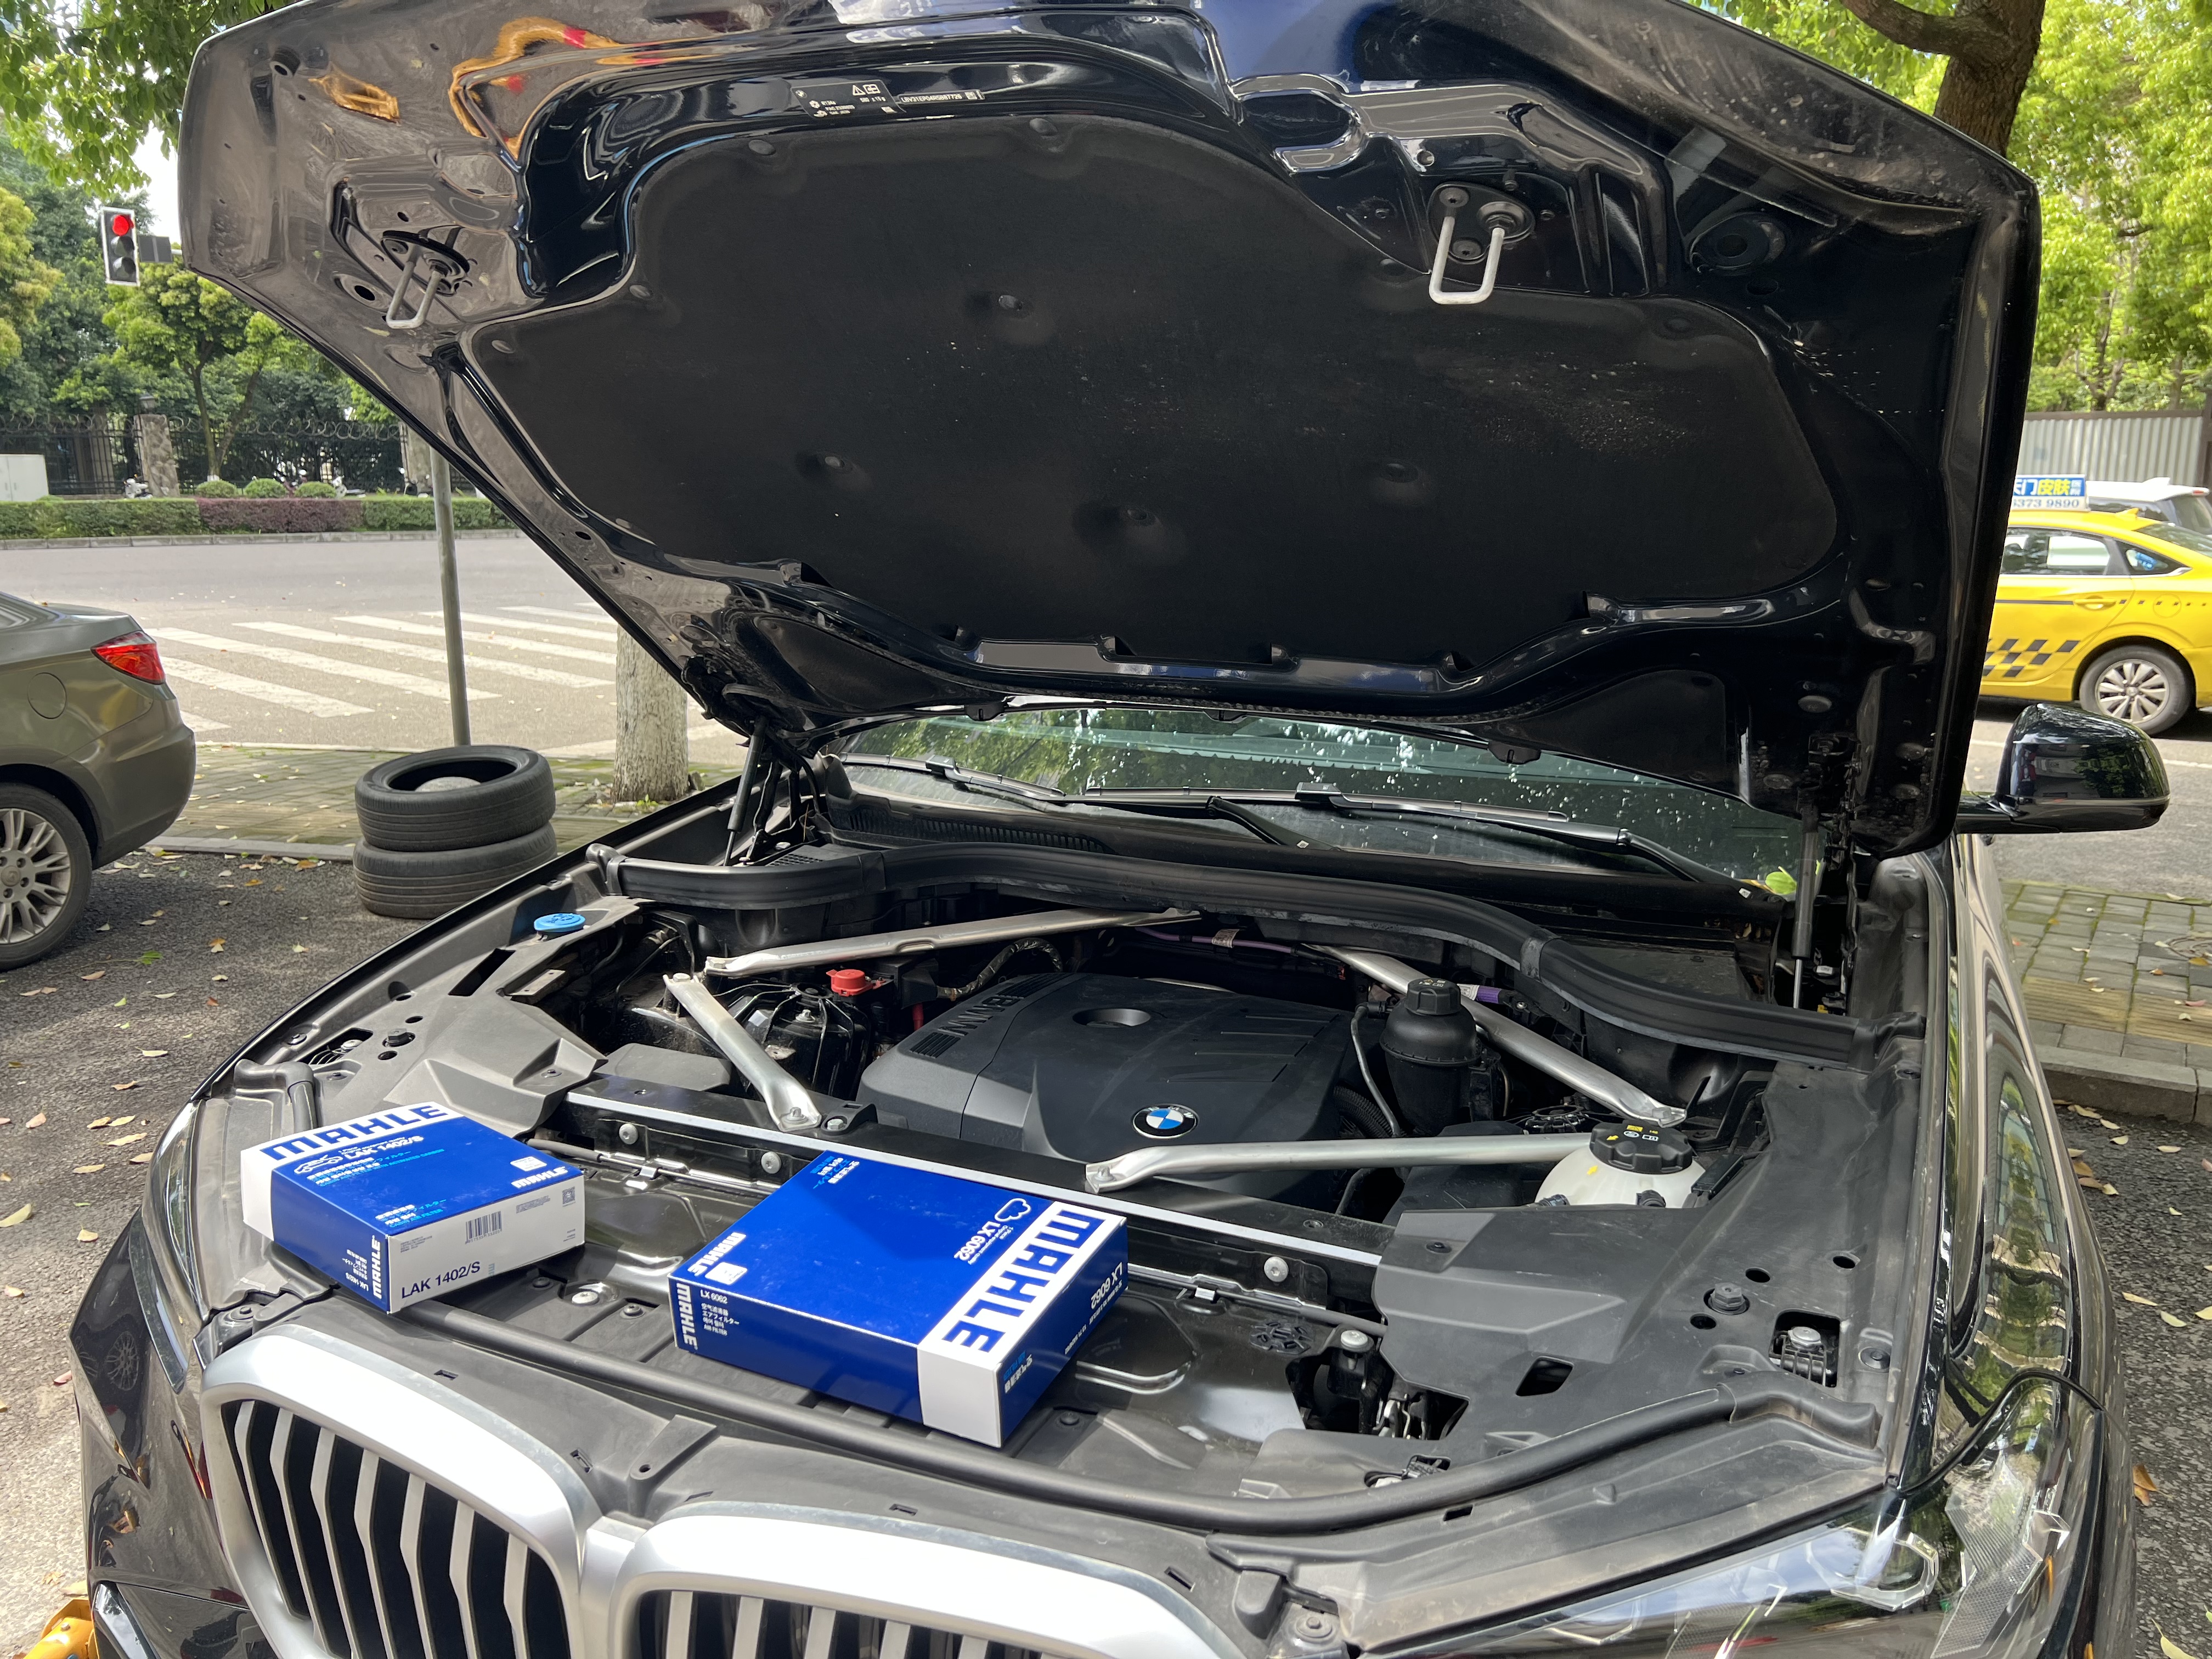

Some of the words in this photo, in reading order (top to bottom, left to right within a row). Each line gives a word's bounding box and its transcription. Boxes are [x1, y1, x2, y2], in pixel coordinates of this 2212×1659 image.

[2046, 499, 2080, 508] 9890
[938, 996, 1021, 1036] BMW
[259, 1104, 449, 1161] MAHLE
[344, 1148, 378, 1159] LAK
[377, 1136, 424, 1151] 1402/S
[511, 1166, 568, 1189] MAHLE
[977, 1221, 1001, 1237] LX
[687, 1232, 746, 1276] MAHLE
[953, 1235, 986, 1261] 6062
[371, 1238, 382, 1299] MAHLE
[402, 1278, 431, 1299] LAK
[435, 1261, 481, 1286] 1402/S
[943, 1208, 1106, 1352] MAHLE
[1111, 1262, 1123, 1285] LX
[700, 1289, 710, 1300] LX
[710, 1293, 728, 1305] 6062
[1091, 1277, 1111, 1310] 6062
[676, 1283, 697, 1347] MAHLE
